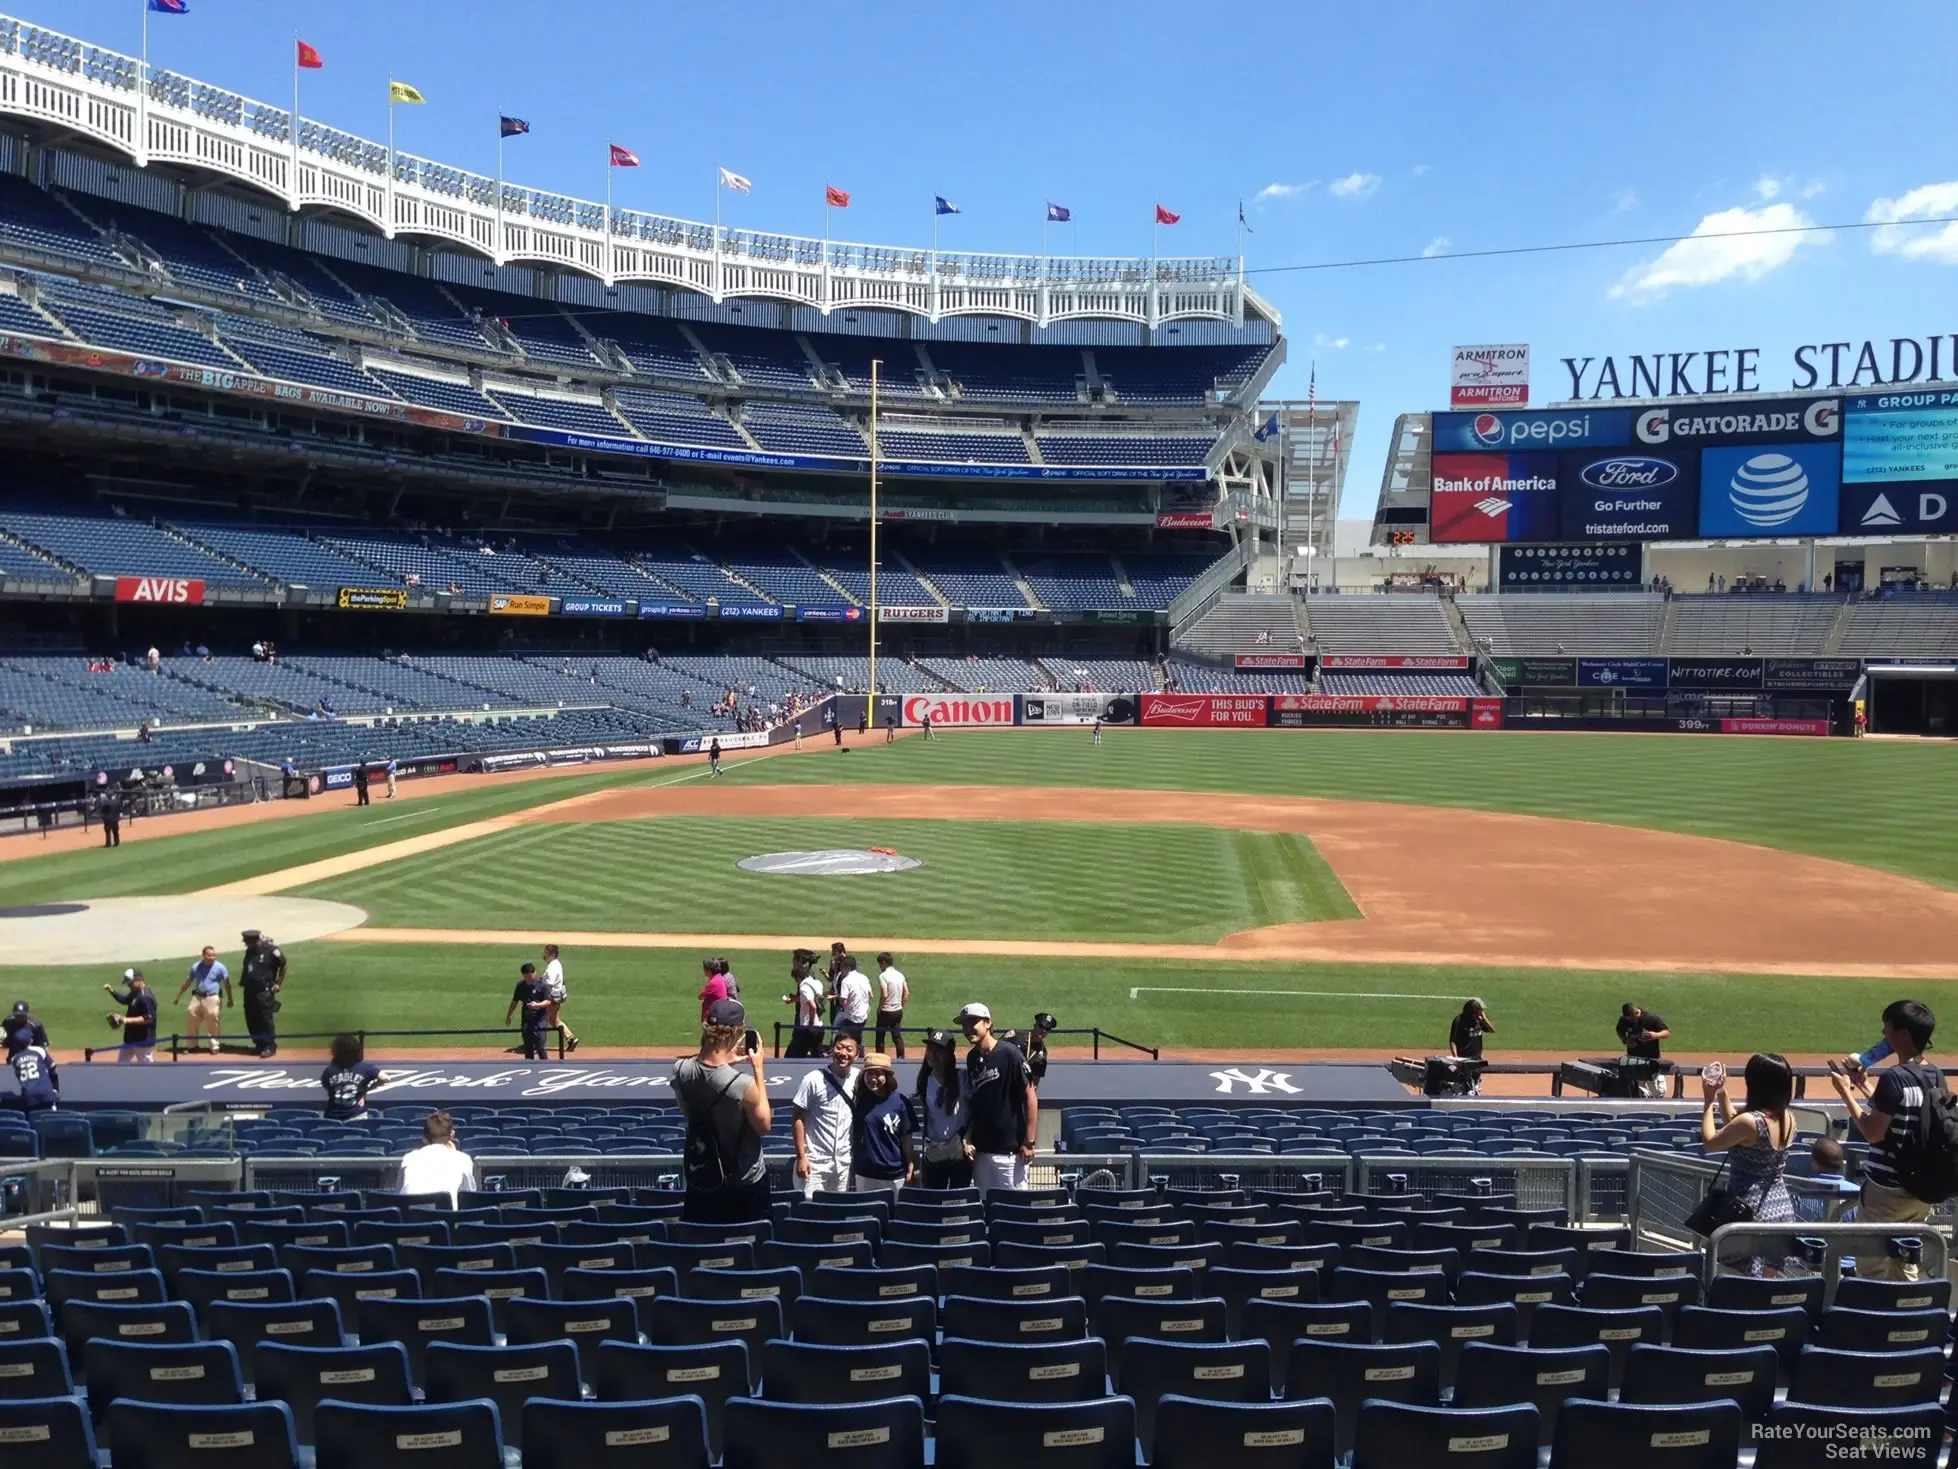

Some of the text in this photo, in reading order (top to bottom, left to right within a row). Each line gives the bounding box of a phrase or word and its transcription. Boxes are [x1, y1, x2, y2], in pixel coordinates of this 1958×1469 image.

[1456, 349, 1526, 361] ARMITRON
[1560, 347, 1760, 401] YANKEE
[201, 371, 234, 389] BIG
[275, 385, 302, 400] BAGS
[309, 392, 363, 410] AVAILABLE
[365, 402, 389, 415] NOW!
[1458, 386, 1521, 397] ARMITRON
[1878, 395, 1936, 408] GROUP
[1673, 412, 1800, 436] GATORADE
[1889, 420, 1909, 429] For
[1909, 418, 1945, 429] groups
[1511, 415, 1590, 444] pepsi
[1917, 432, 1939, 441] next
[568, 435, 581, 446] For
[597, 438, 635, 452] information
[636, 443, 649, 453] call
[700, 450, 722, 461] E-mail
[723, 453, 795, 466] events@Yankees.com
[1891, 441, 1949, 452] all-inclusive
[1599, 461, 1658, 485] Ford
[1866, 466, 1887, 474] (212)
[1888, 464, 1926, 473] YANKEES
[1433, 475, 1556, 493] Bank of America
[1594, 500, 1662, 512] Go Further
[908, 511, 937, 519] YANKEES
[1158, 516, 1212, 527] Budweiser
[1585, 522, 1669, 535] tristateford.com
[133, 579, 189, 602] AVIS
[494, 600, 546, 611] SAP Run Simple
[565, 603, 622, 612] GROUP TICKETS
[721, 606, 779, 617] (212) YANKEES
[803, 610, 841, 618] yankees.com
[883, 608, 944, 619] RUTGERS
[1671, 665, 1761, 679] NITTOTIRE.COM
[904, 697, 1012, 723] Canon
[1150, 703, 1199, 715] Budweiser
[1211, 699, 1265, 710] THIS BUD'S
[1211, 711, 1254, 721] FOR YOU.
[1779, 723, 1817, 732] DONUTS
[684, 739, 699, 748] ACC
[407, 766, 416, 774] A4
[327, 774, 352, 785] GEICO
[203, 1070, 323, 1090] New
[1208, 1067, 1305, 1094] NY
